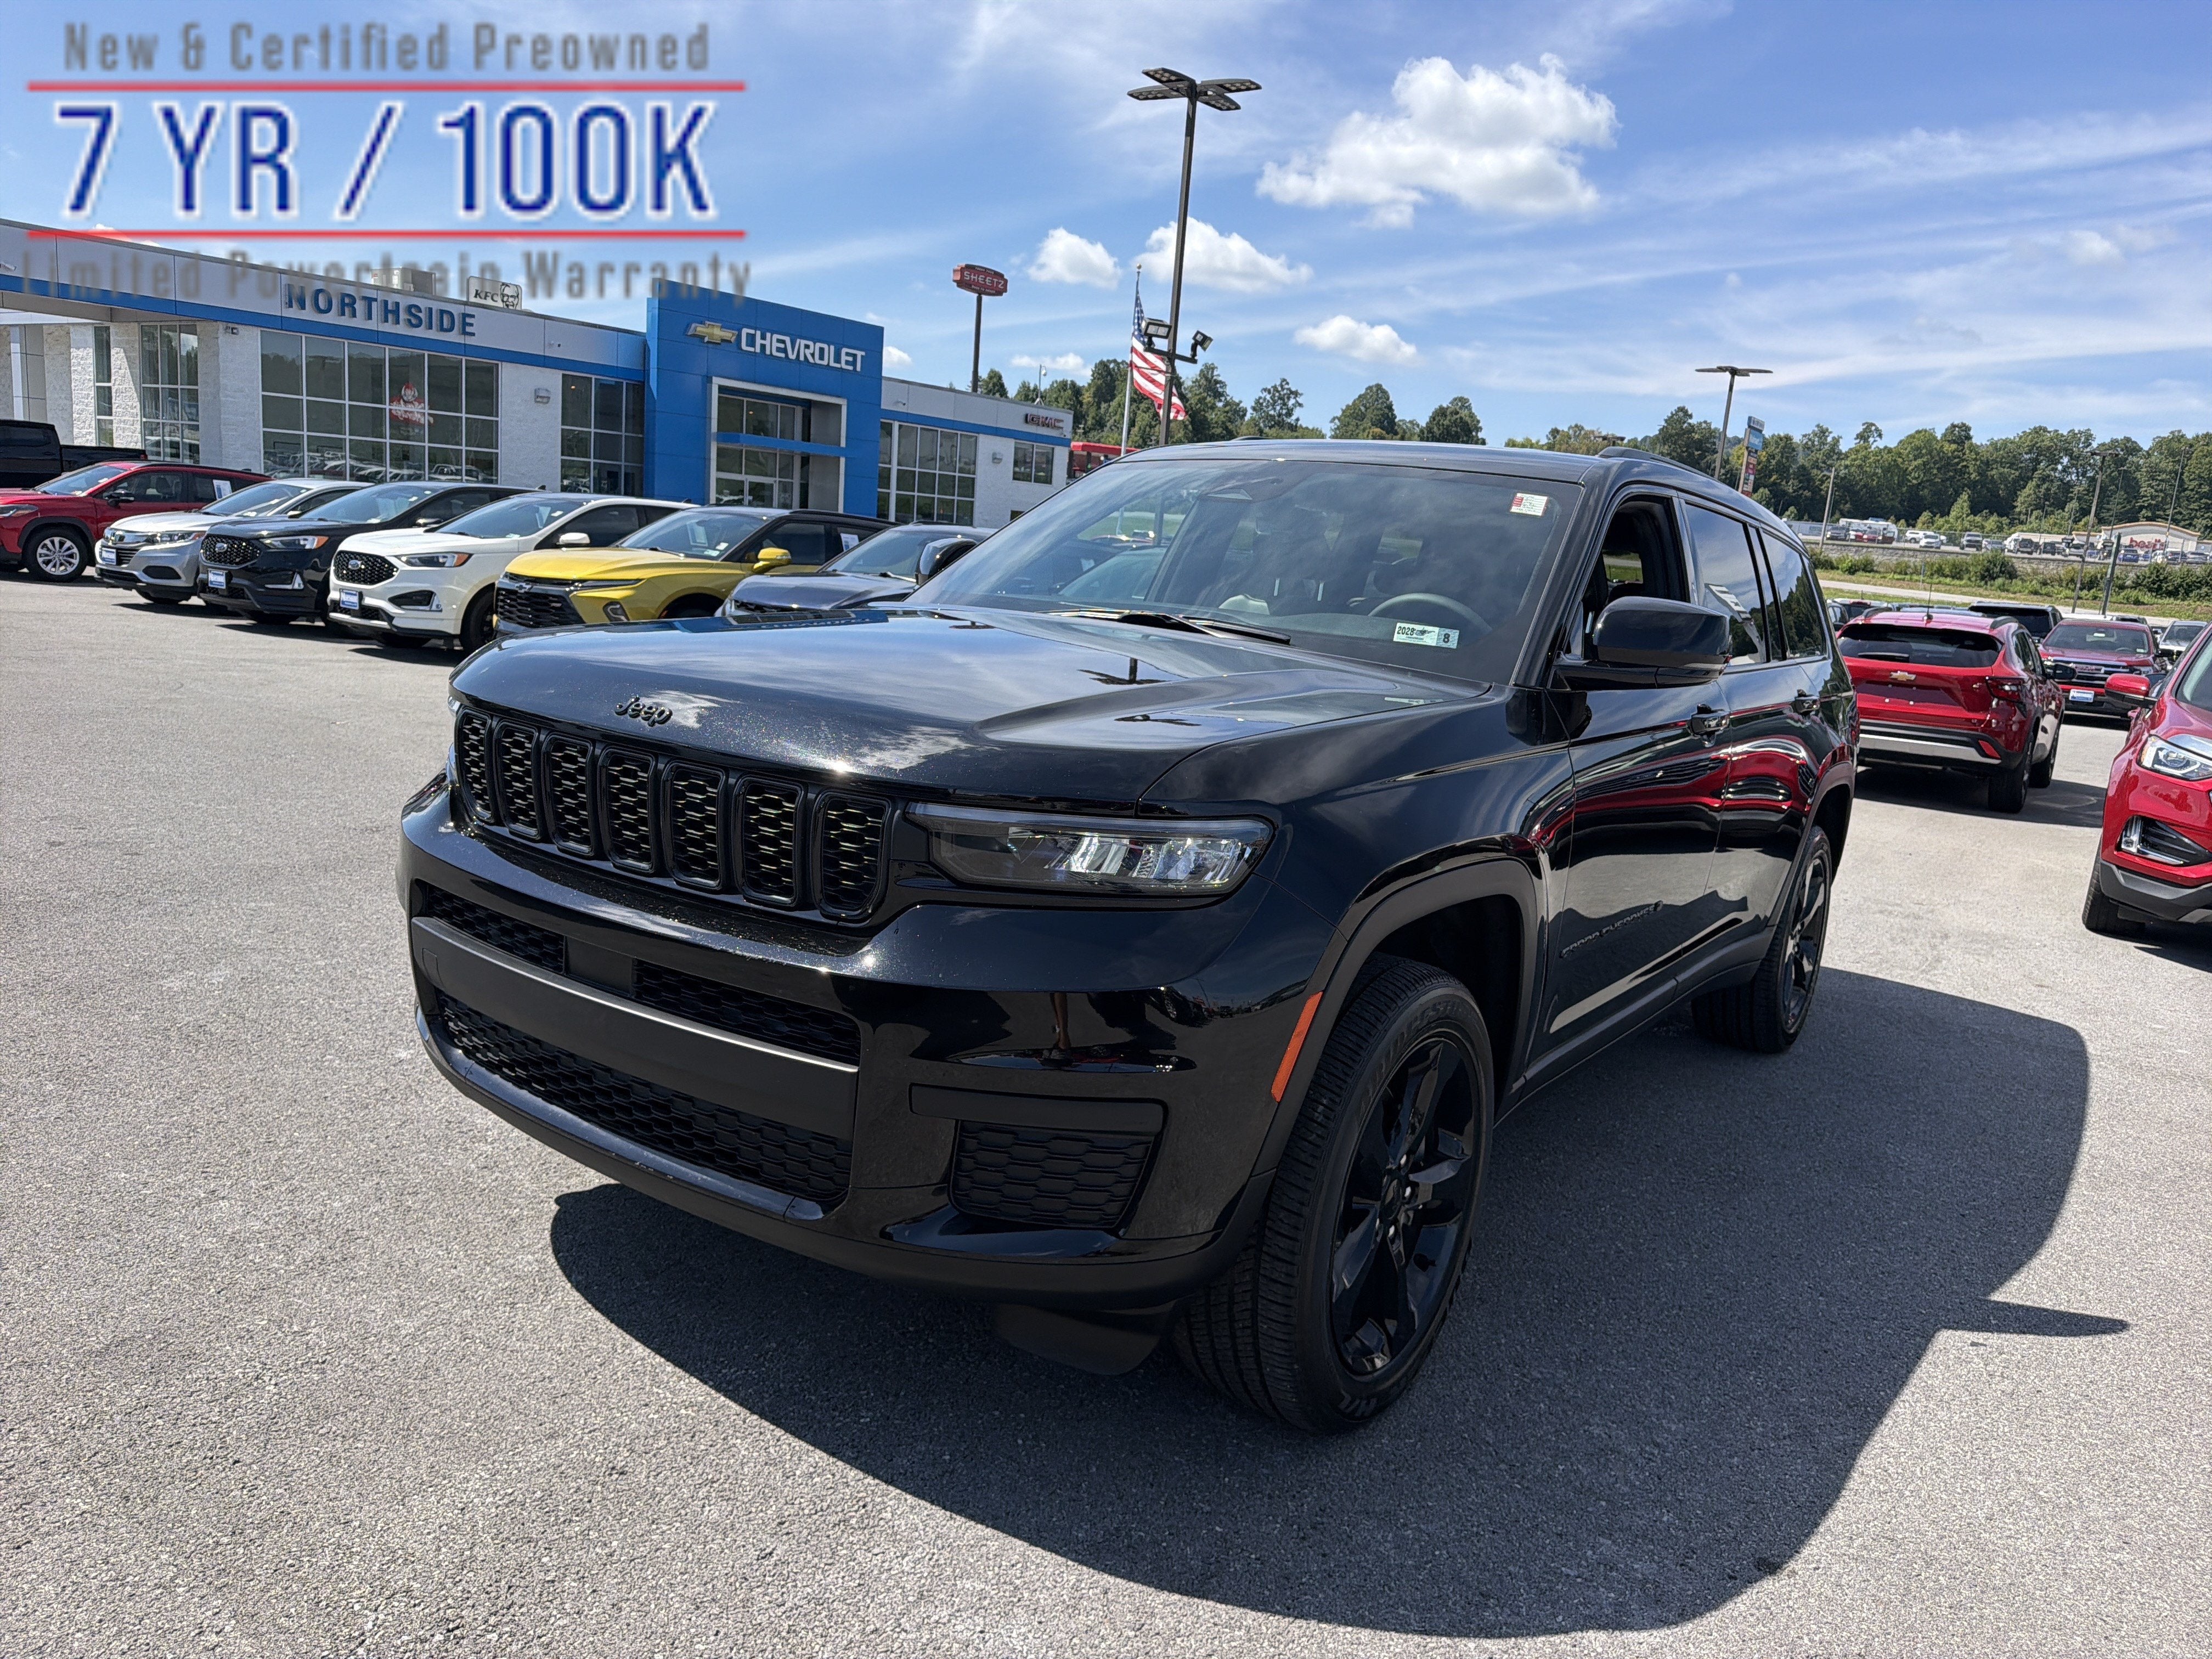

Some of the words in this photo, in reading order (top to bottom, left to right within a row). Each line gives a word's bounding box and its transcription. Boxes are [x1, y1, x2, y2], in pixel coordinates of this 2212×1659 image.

[963, 271, 1005, 289] SHEETZ
[473, 289, 499, 303] KFC
[286, 283, 476, 337] NORTHSIDE
[741, 328, 866, 372] CHEVROLET
[1028, 413, 1064, 429] GMC
[1396, 626, 1415, 636] 2028
[1442, 633, 1451, 644] 8
[614, 695, 673, 727] Jeep
